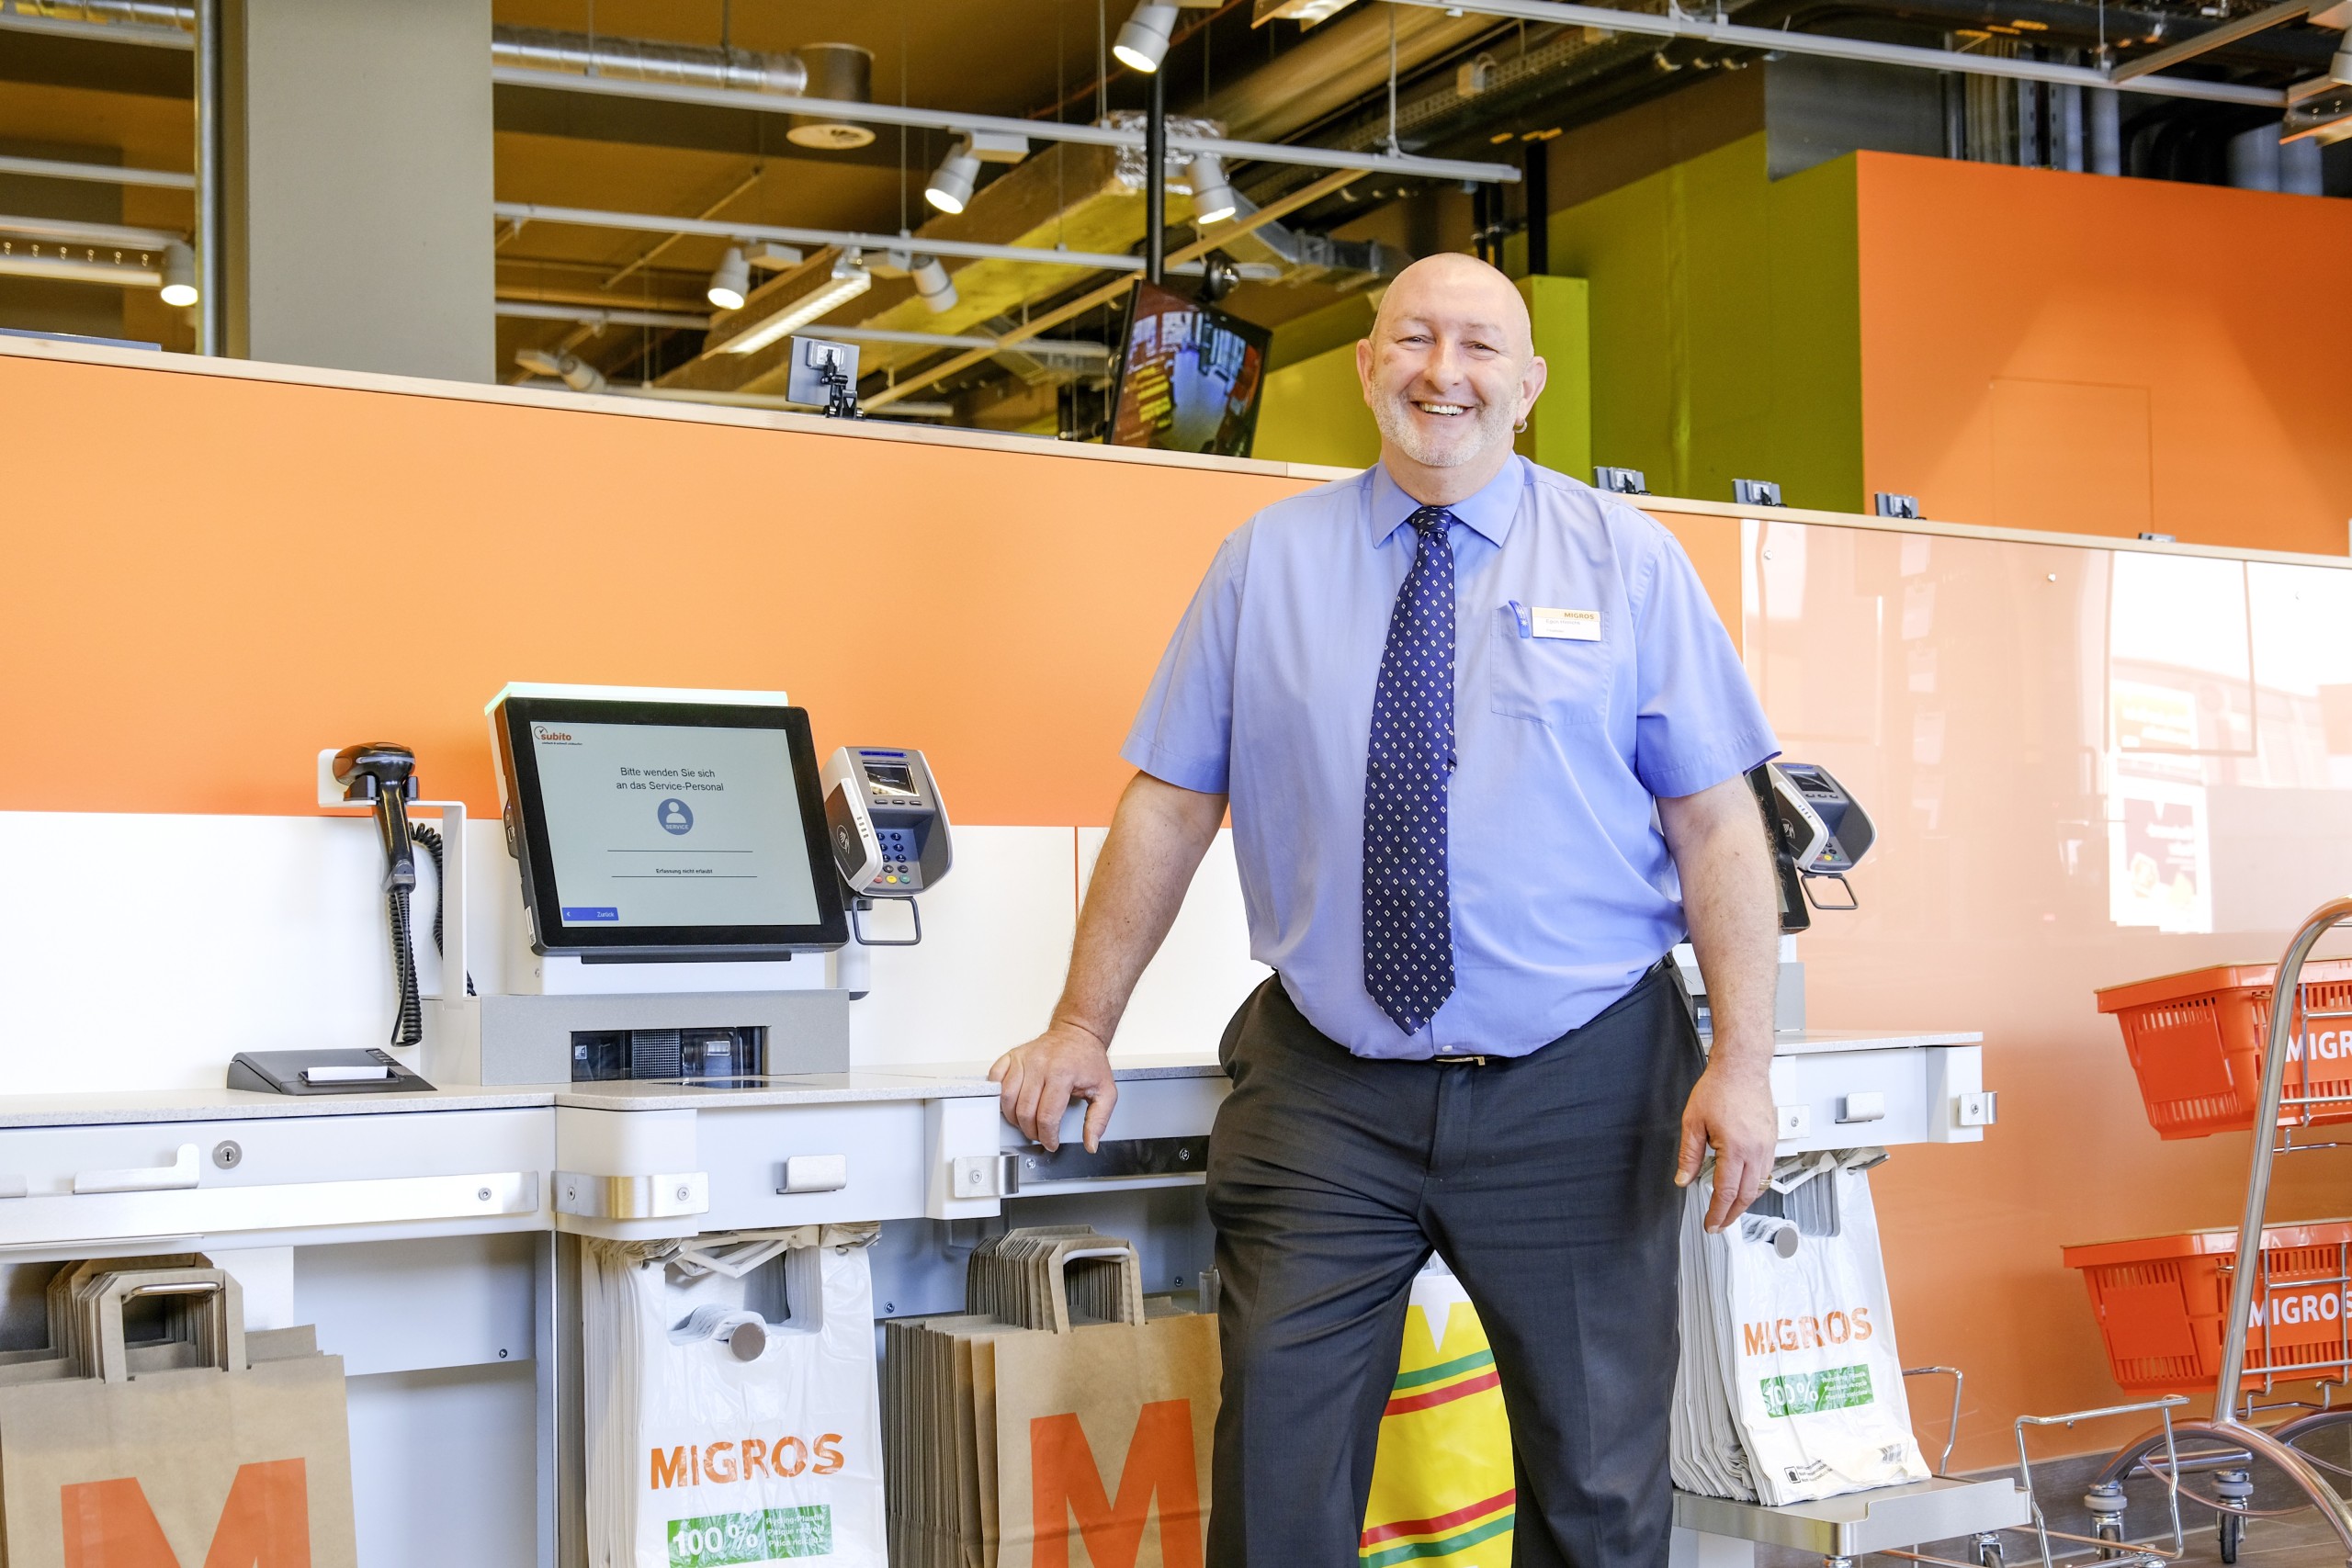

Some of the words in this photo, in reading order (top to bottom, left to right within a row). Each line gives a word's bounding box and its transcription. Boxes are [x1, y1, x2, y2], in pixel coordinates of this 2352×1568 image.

[540, 732, 571, 741] subito
[616, 782, 628, 790] an
[629, 782, 647, 790] das
[649, 782, 724, 791] Service-Personal
[620, 767, 641, 776] Bitte
[643, 768, 679, 777] wenden
[681, 769, 695, 777] Sie
[697, 769, 716, 778] sich
[1743, 1307, 1872, 1357] MIGROS
[650, 1433, 845, 1490] MIGROS
[1030, 1398, 1204, 1568] M
